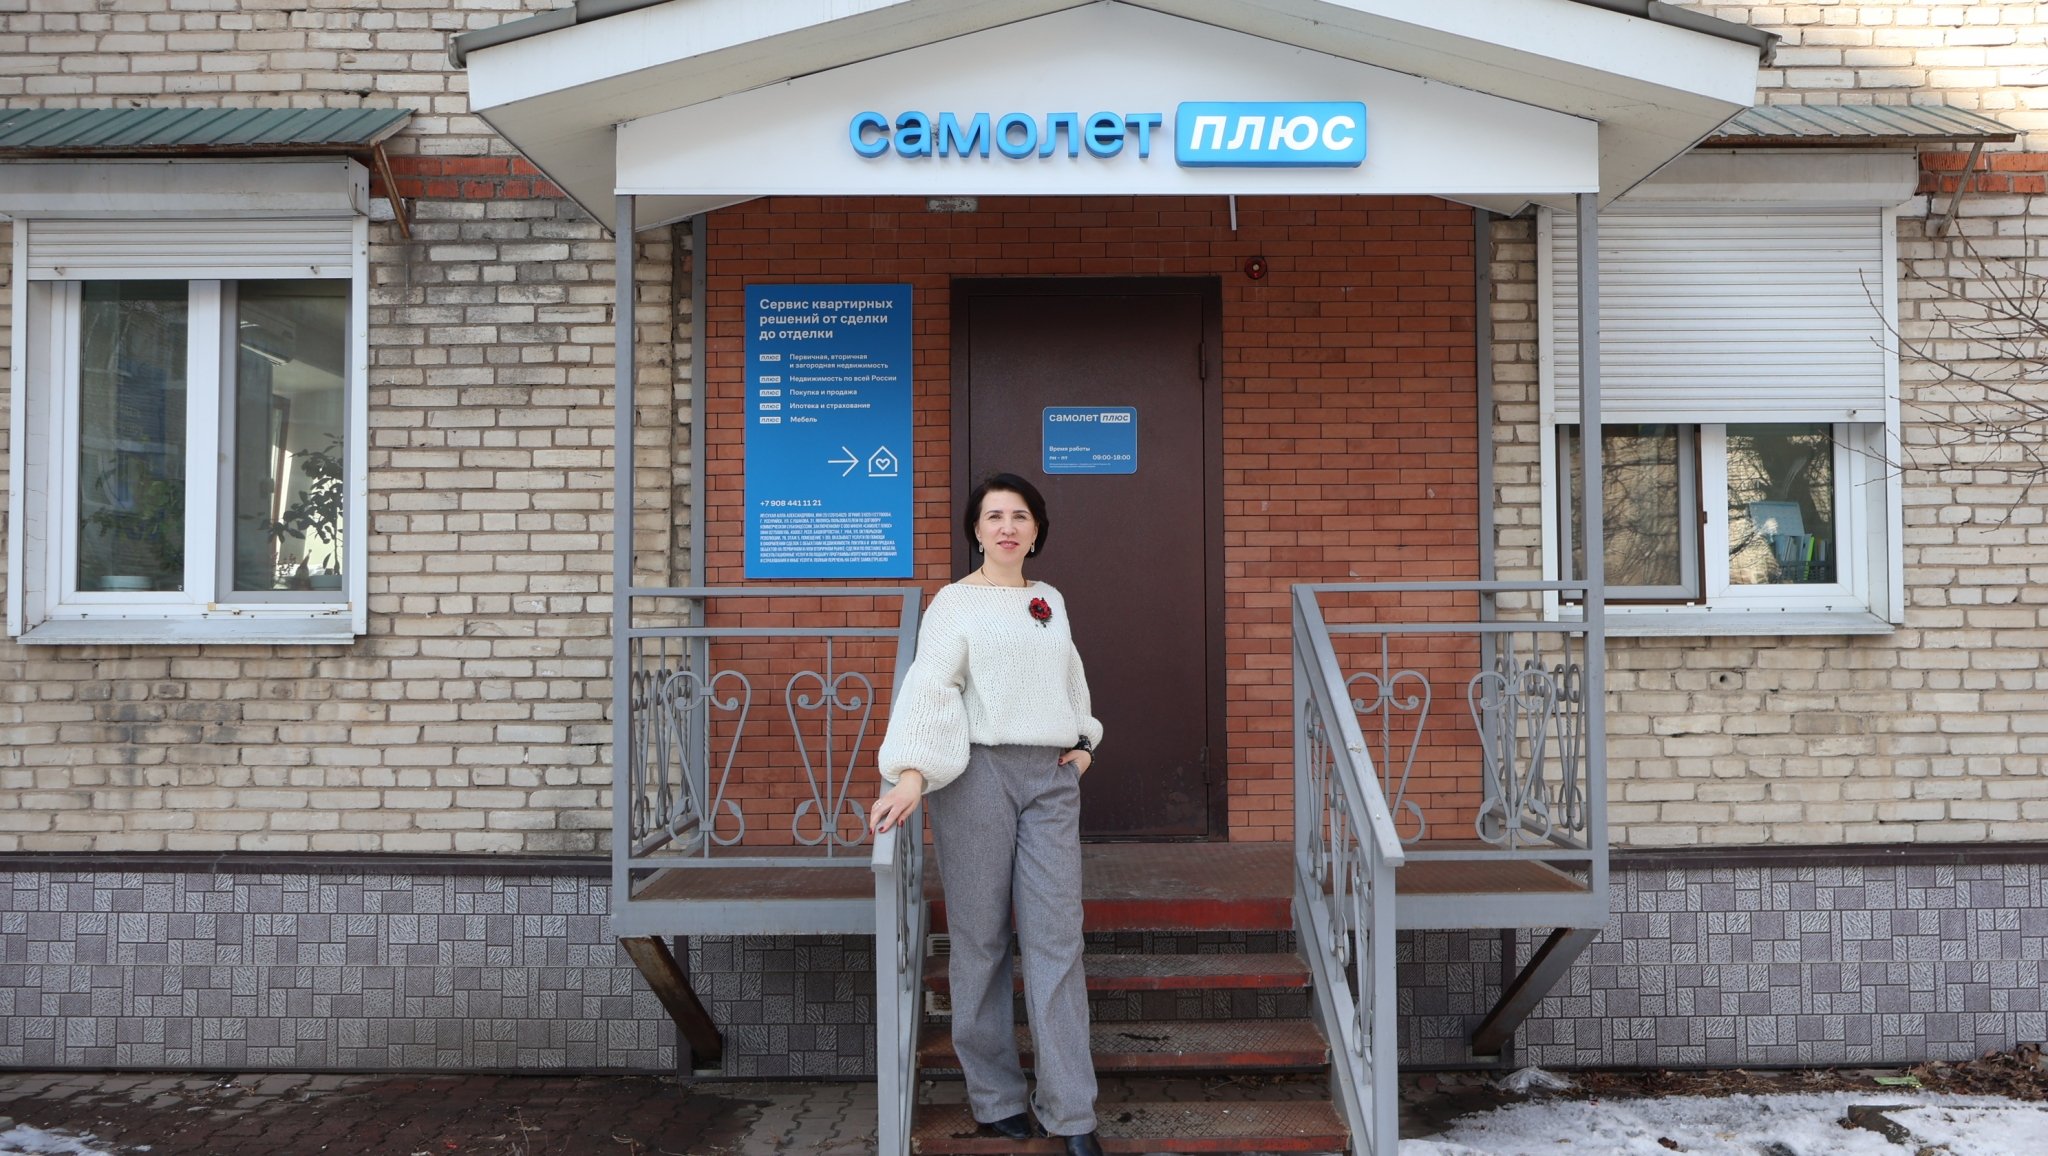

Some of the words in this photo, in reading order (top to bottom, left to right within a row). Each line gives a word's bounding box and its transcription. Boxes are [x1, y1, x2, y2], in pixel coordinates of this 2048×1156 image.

[849, 110, 1163, 159] самолет
[1189, 115, 1357, 151] плюс
[760, 299, 809, 312] Сервис
[812, 299, 893, 311] квартирных
[759, 313, 820, 326] решений
[822, 314, 838, 324] от
[840, 314, 888, 325] сделки
[759, 329, 776, 341] до
[778, 329, 833, 340] отделки
[789, 353, 830, 361] Первичная,
[789, 375, 843, 383] Недвижимость
[789, 389, 820, 397] Покупка
[826, 389, 858, 397] продажа
[826, 402, 871, 410] страхование
[1049, 414, 1099, 422] самолет
[1102, 414, 1129, 422] плюс
[770, 499, 786, 507] 908
[787, 499, 802, 507] 441
[802, 499, 812, 507] 11
[812, 499, 822, 507] 21
